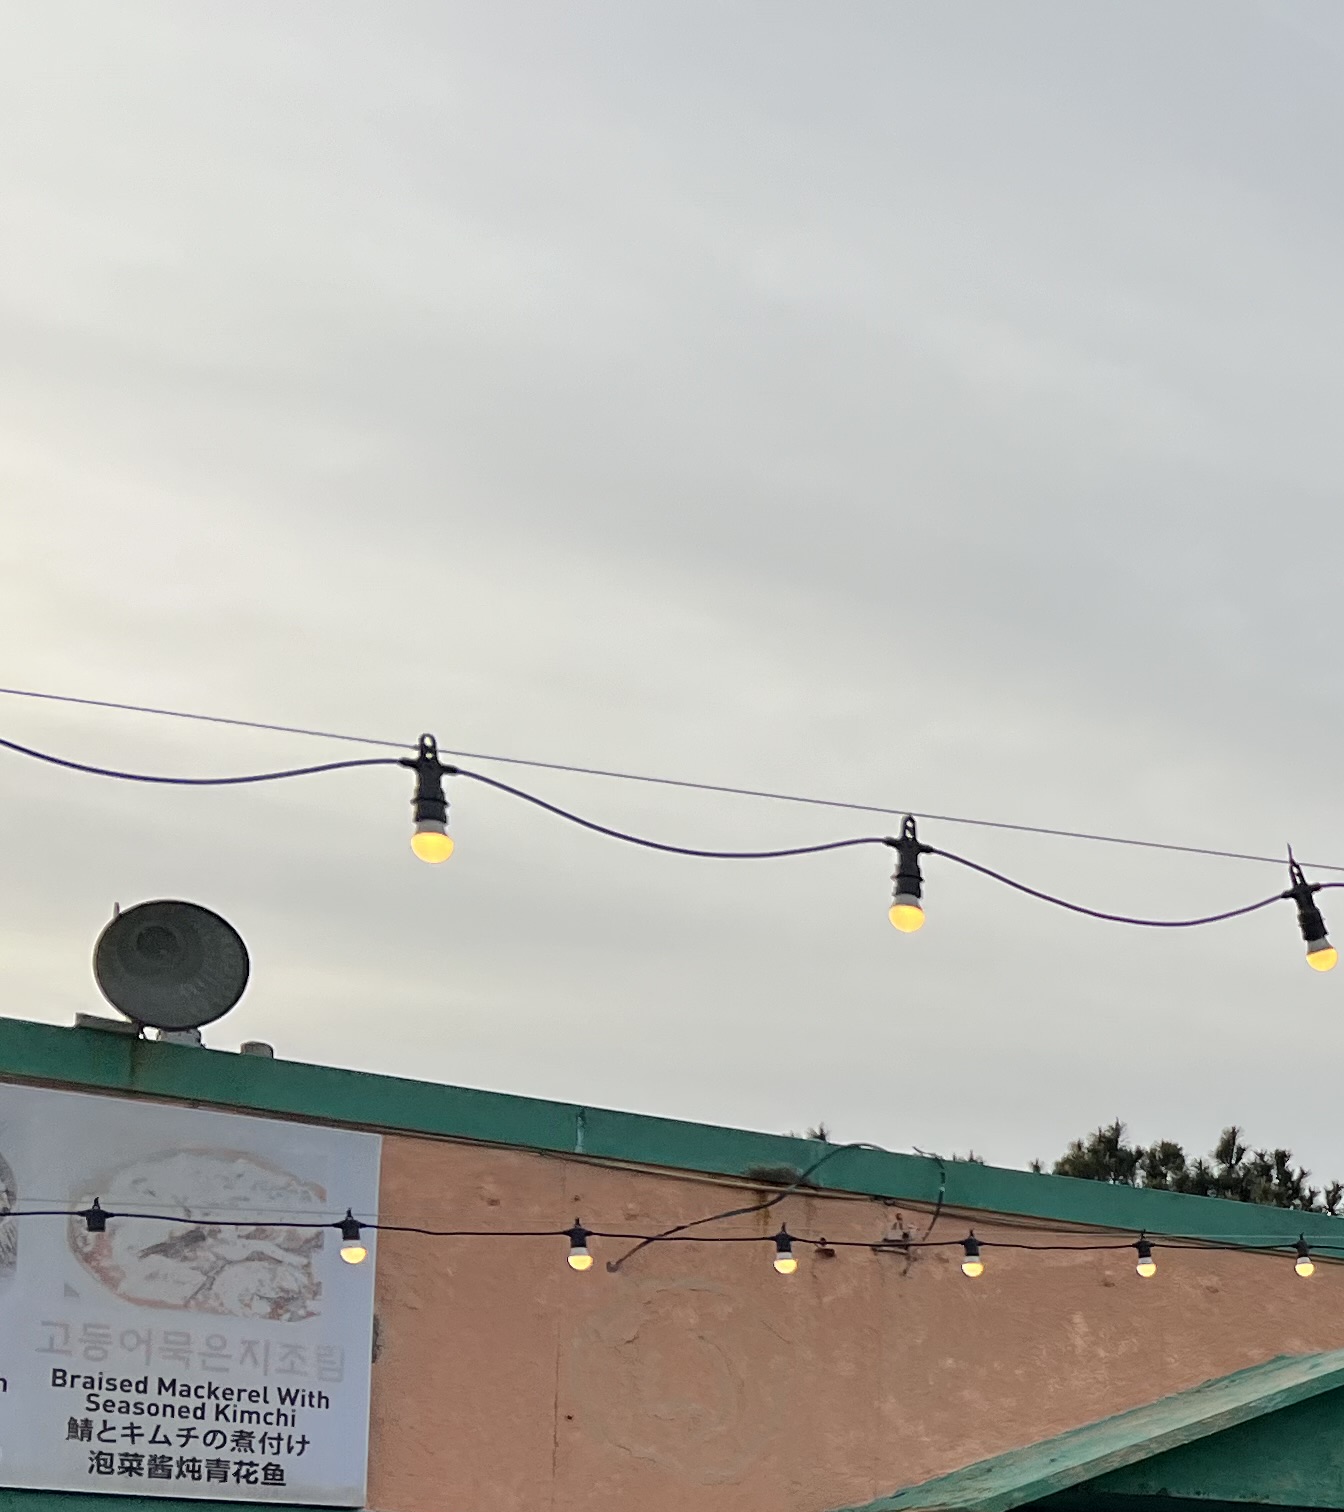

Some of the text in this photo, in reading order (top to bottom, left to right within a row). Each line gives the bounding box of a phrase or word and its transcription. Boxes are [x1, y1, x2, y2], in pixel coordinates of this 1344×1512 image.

[36, 1320, 346, 1383] 고등어묵은지조림
[51, 1368, 330, 1409] Braised Mackerel With
[85, 1394, 297, 1427] Seasoned Kimchi
[65, 1416, 311, 1456] 鯖とキムチの煮付け
[88, 1450, 287, 1487] 泡菜酱炖青花鱼
